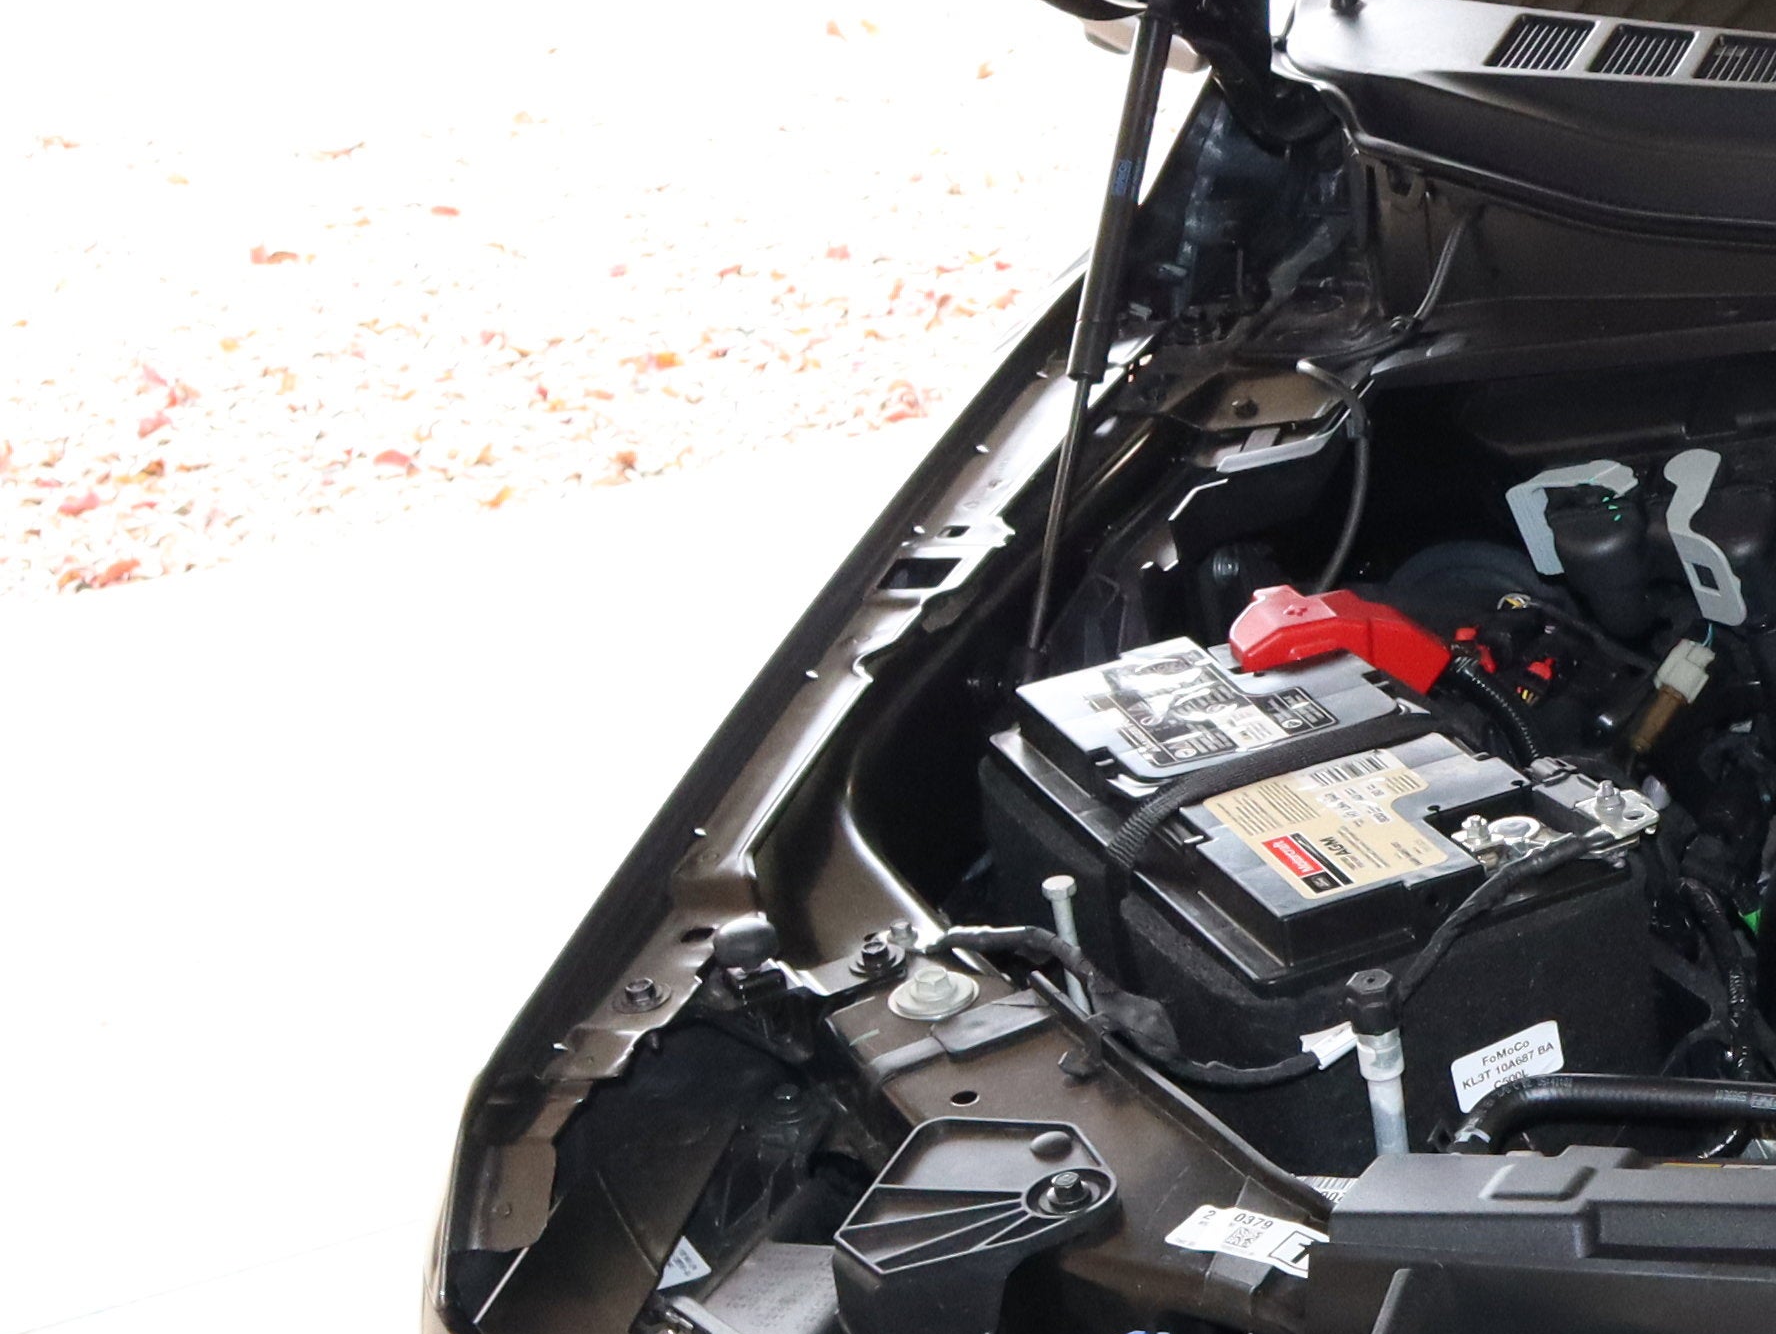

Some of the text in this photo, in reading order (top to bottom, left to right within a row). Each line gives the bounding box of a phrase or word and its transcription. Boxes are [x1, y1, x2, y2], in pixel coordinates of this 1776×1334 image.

[1270, 839, 1316, 874] Motorcraft
[1319, 836, 1352, 857] AGM
[1481, 1040, 1530, 1066] FoMoCo
[1461, 1069, 1491, 1090] KL3T
[1496, 1050, 1534, 1074] 10A687
[1537, 1042, 1554, 1055] BA
[1203, 1210, 1217, 1220] 2
[1233, 1212, 1274, 1231] 0379
